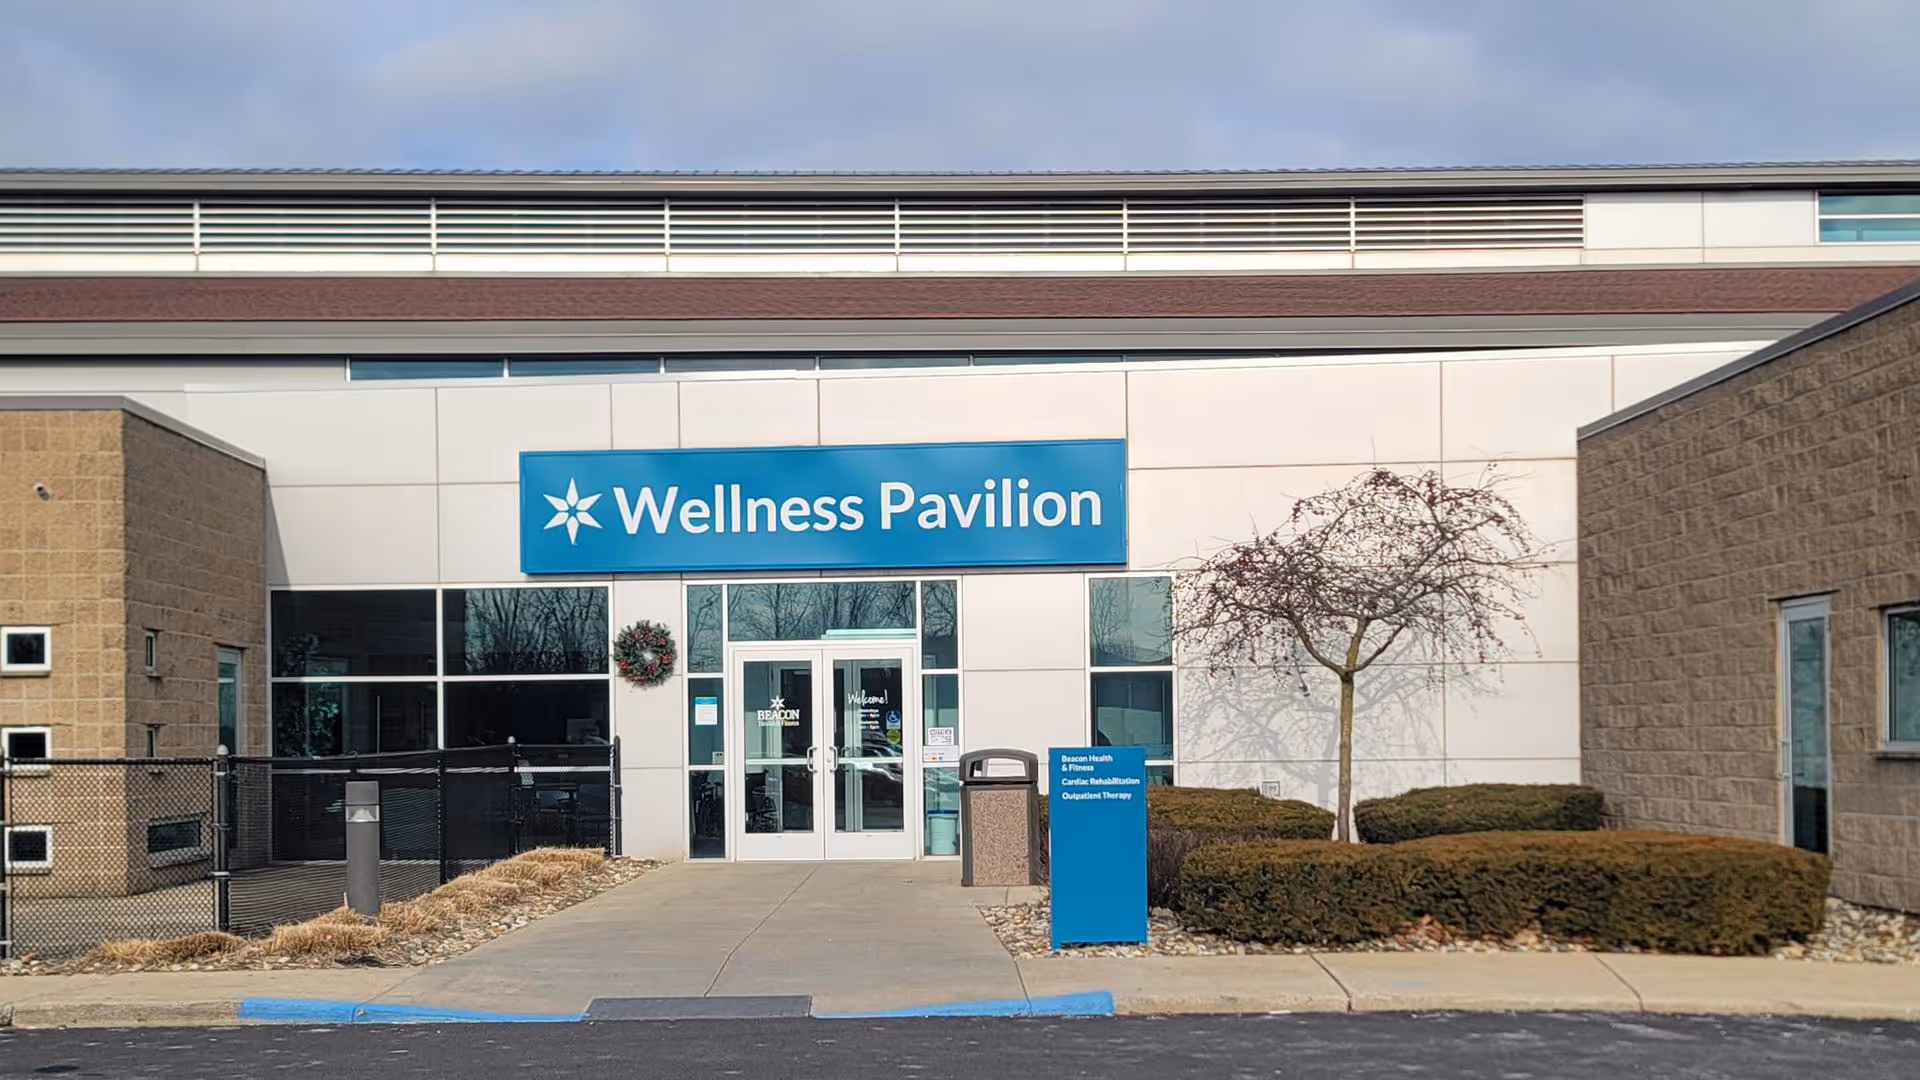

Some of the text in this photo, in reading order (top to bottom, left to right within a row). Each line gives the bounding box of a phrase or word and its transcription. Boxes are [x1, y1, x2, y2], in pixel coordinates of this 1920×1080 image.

[612, 477, 1102, 535] Wellness Pavilion
[847, 689, 888, 706] Welcome!
[757, 709, 800, 720] BEACON
[1061, 754, 1114, 763] Beacon Health
[1061, 764, 1094, 772] & Fitness
[1061, 777, 1140, 786] Cardiac Rehabilitation
[1061, 791, 1132, 800] Outpatient Therapy
